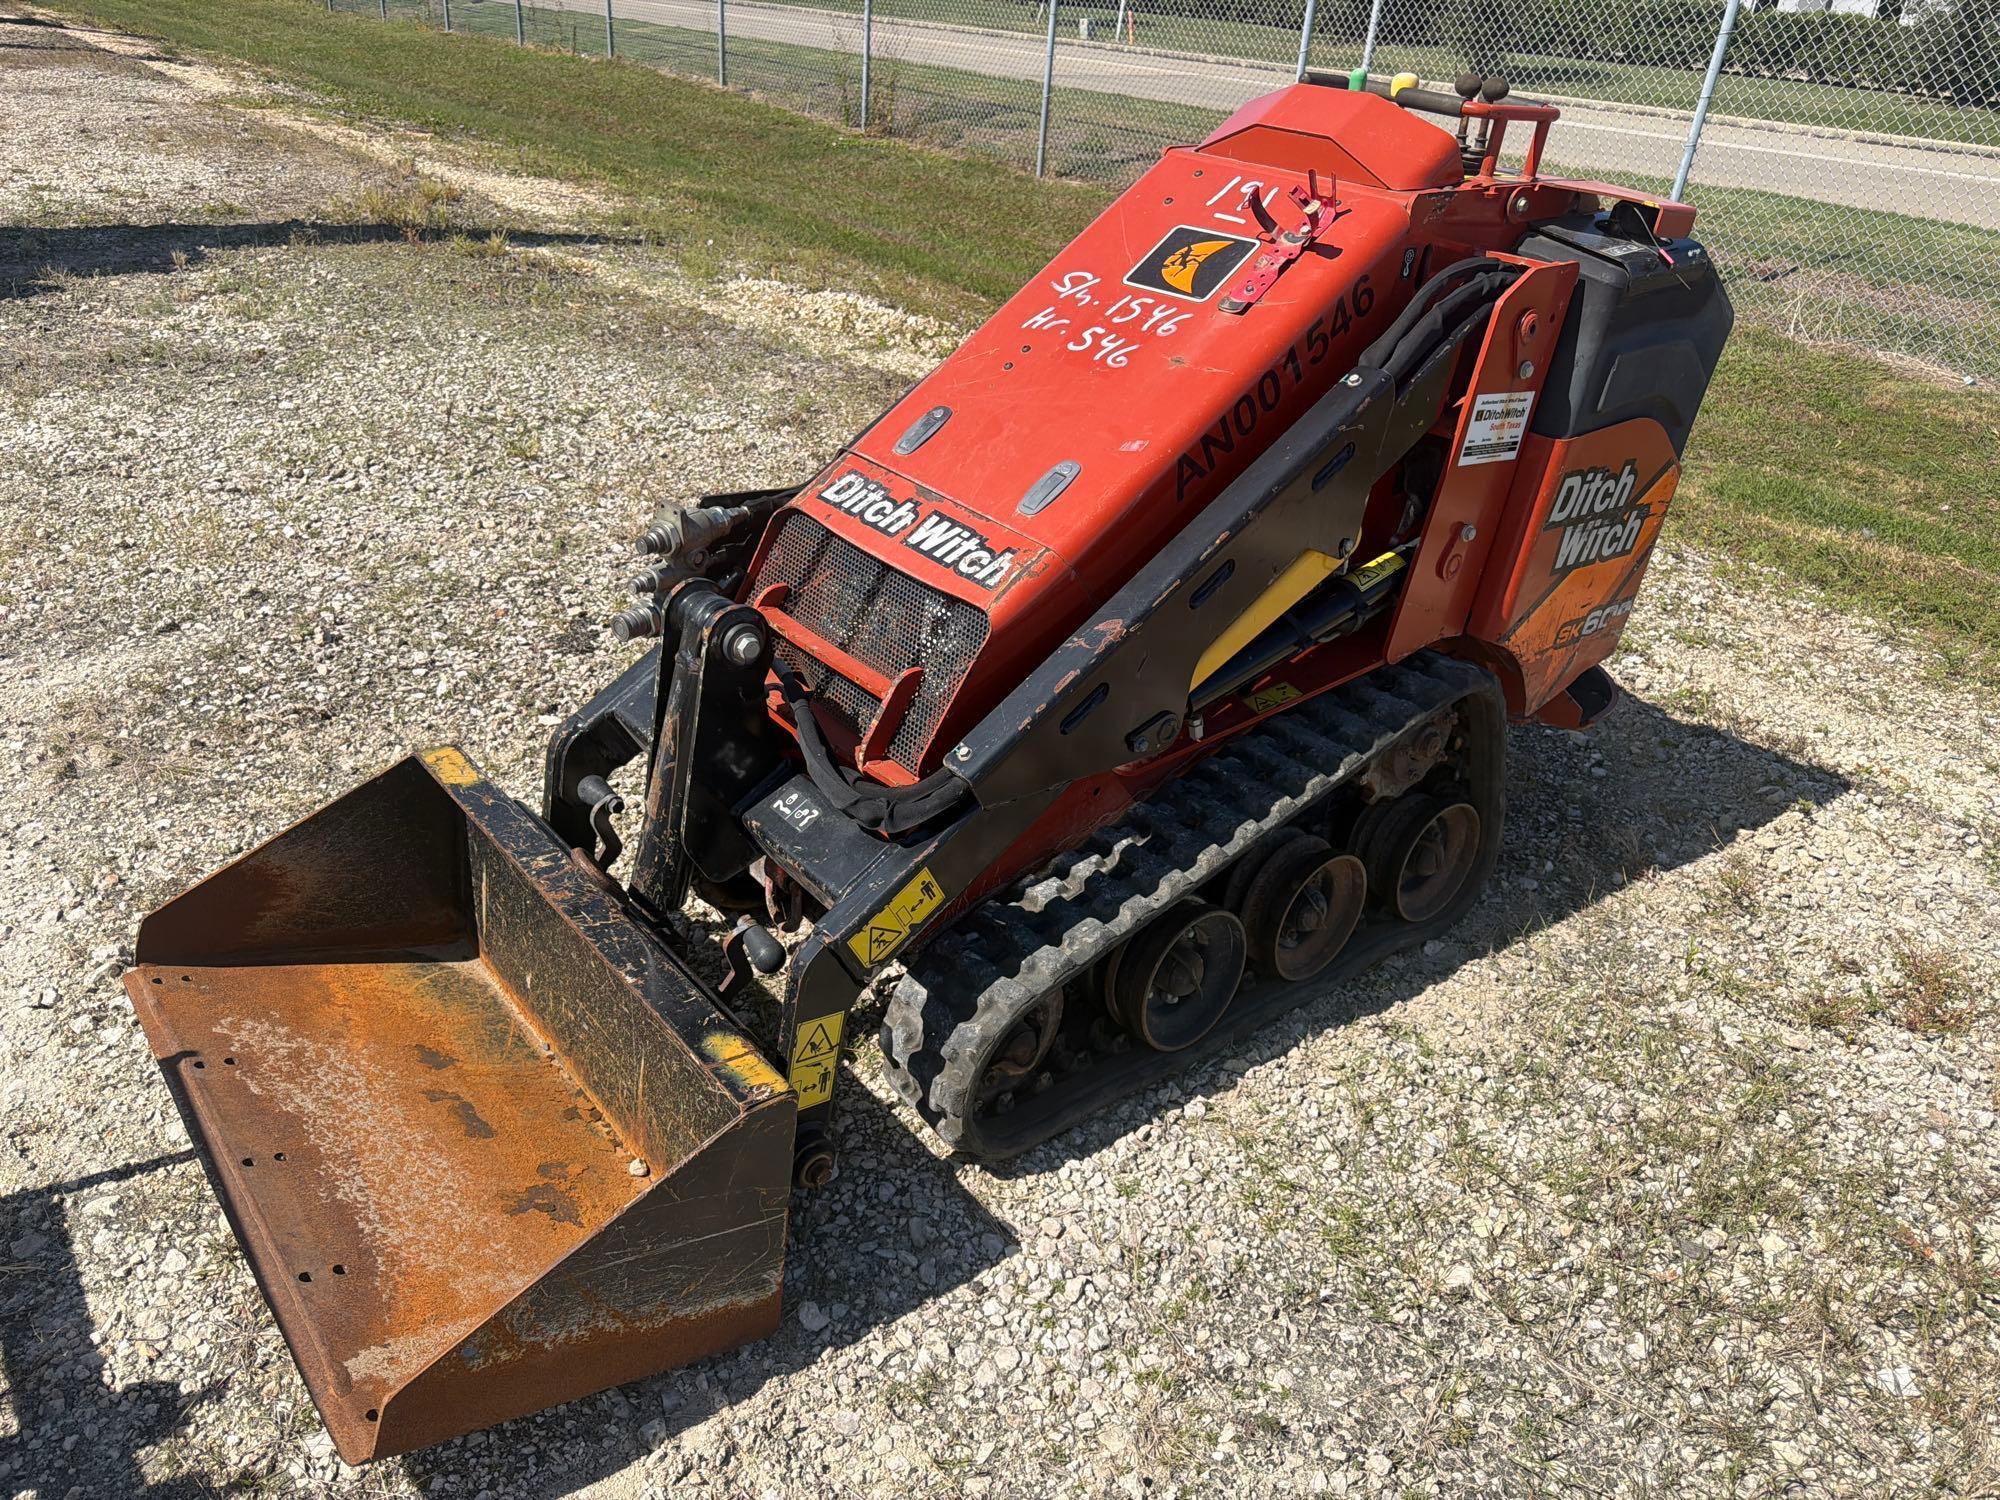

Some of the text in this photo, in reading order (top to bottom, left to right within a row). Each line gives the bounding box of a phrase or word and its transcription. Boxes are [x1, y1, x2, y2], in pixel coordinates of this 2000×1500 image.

[1105, 295, 1194, 337] 1546
[1067, 326, 1139, 369] 546
[1175, 274, 1375, 502] AN001546
[1549, 465, 1636, 523] Ditch
[820, 472, 1016, 588] Ditch Witch
[1555, 511, 1642, 569] Witch
